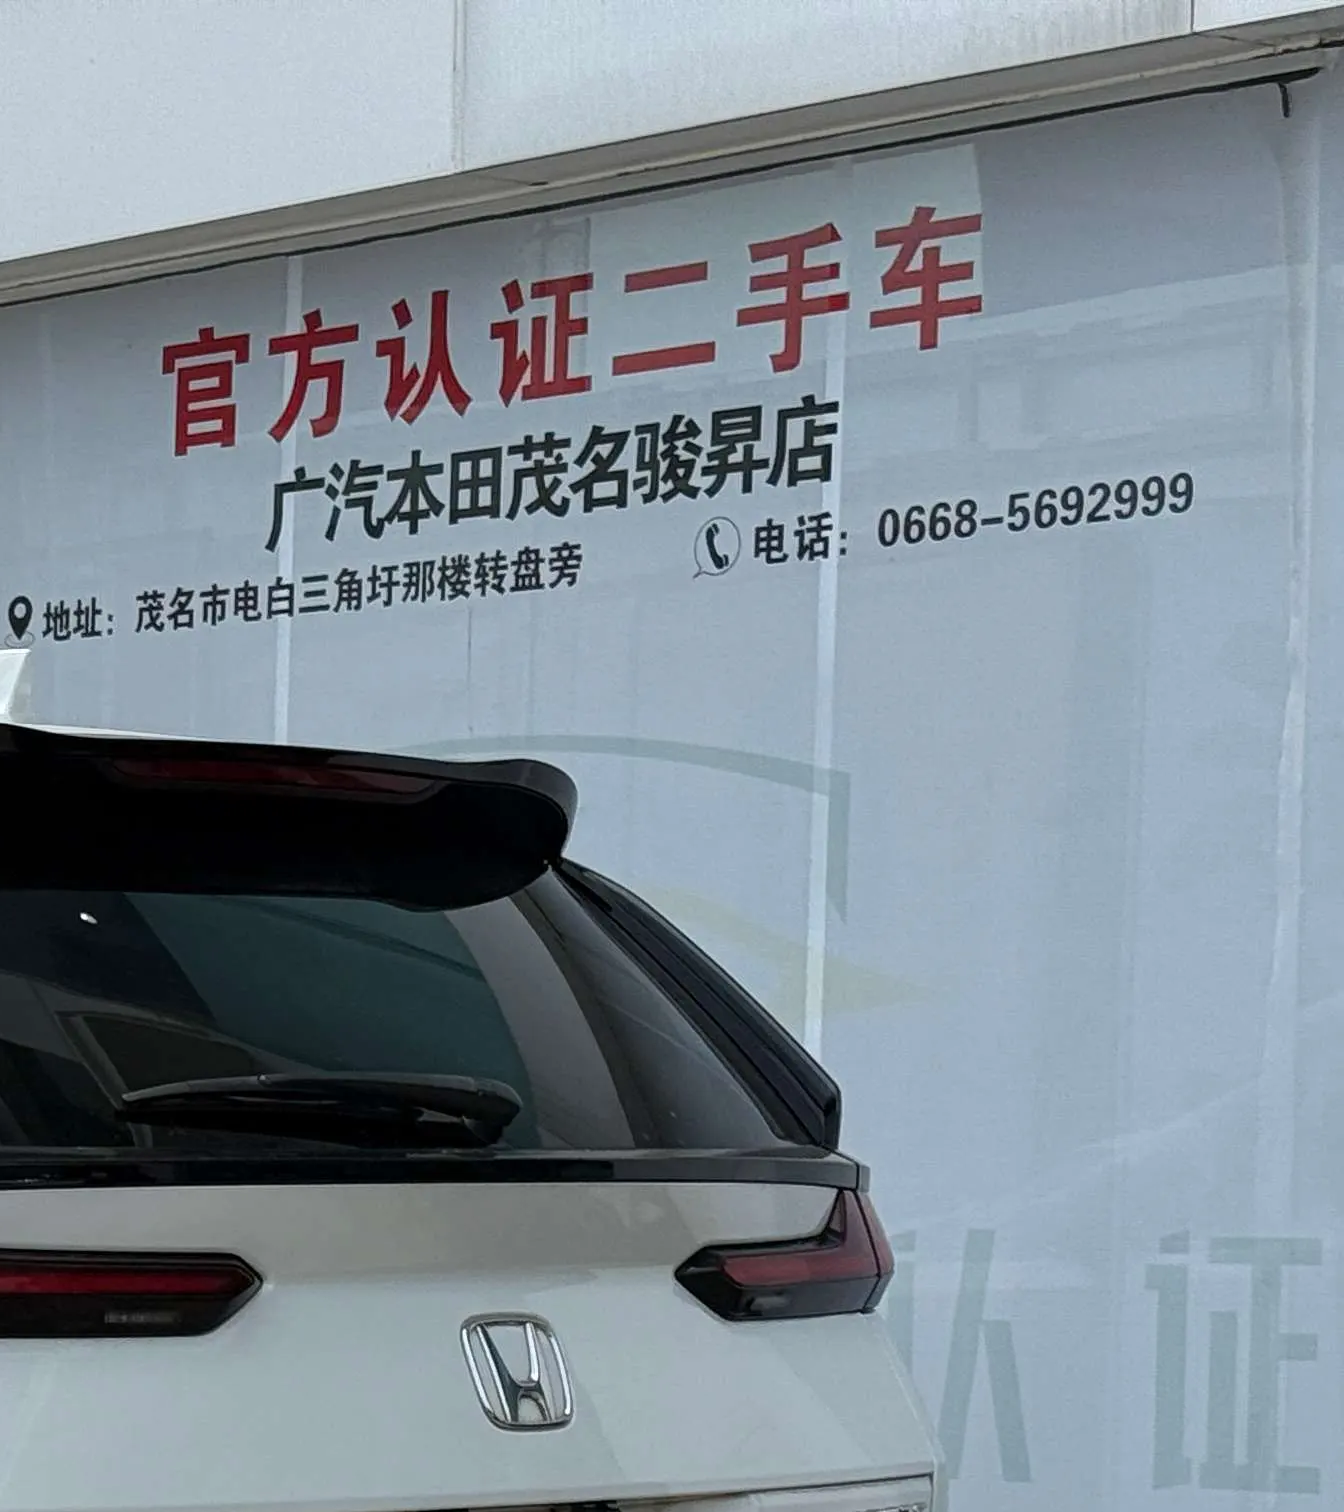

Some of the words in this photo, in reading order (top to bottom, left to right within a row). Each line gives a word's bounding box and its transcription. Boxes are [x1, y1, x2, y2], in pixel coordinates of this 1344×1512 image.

[162, 205, 983, 458] 官方认证二手车
[264, 395, 840, 552] 广汽本田茂名骏昇店
[876, 472, 1194, 548] 0668-5692999
